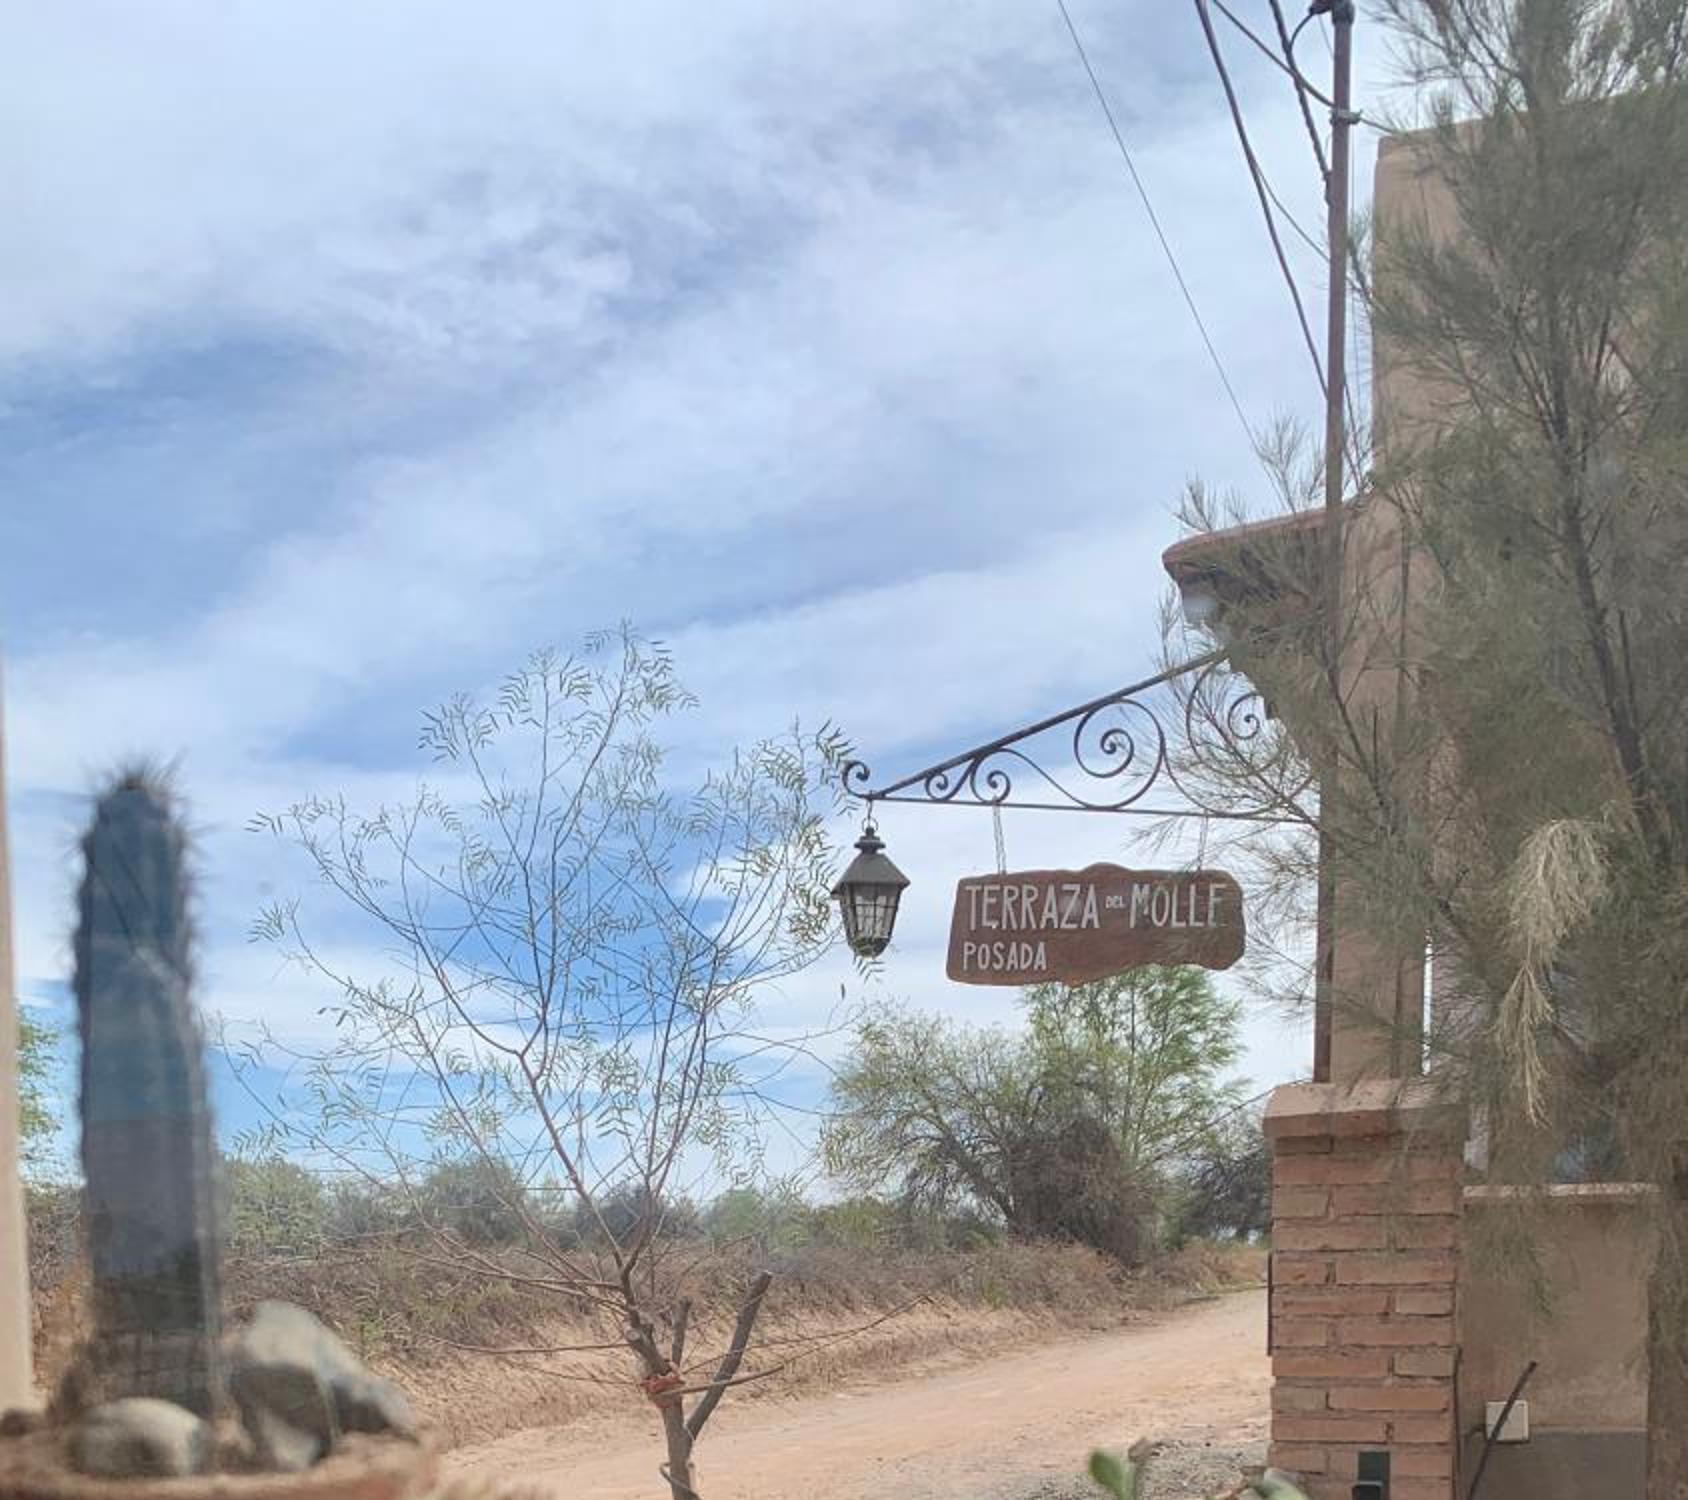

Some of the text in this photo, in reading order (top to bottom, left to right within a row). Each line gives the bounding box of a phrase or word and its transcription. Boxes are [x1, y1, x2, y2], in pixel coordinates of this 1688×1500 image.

[964, 883, 1228, 930] TERRAZA DEL MOLLE
[963, 941, 1047, 971] POSADA
